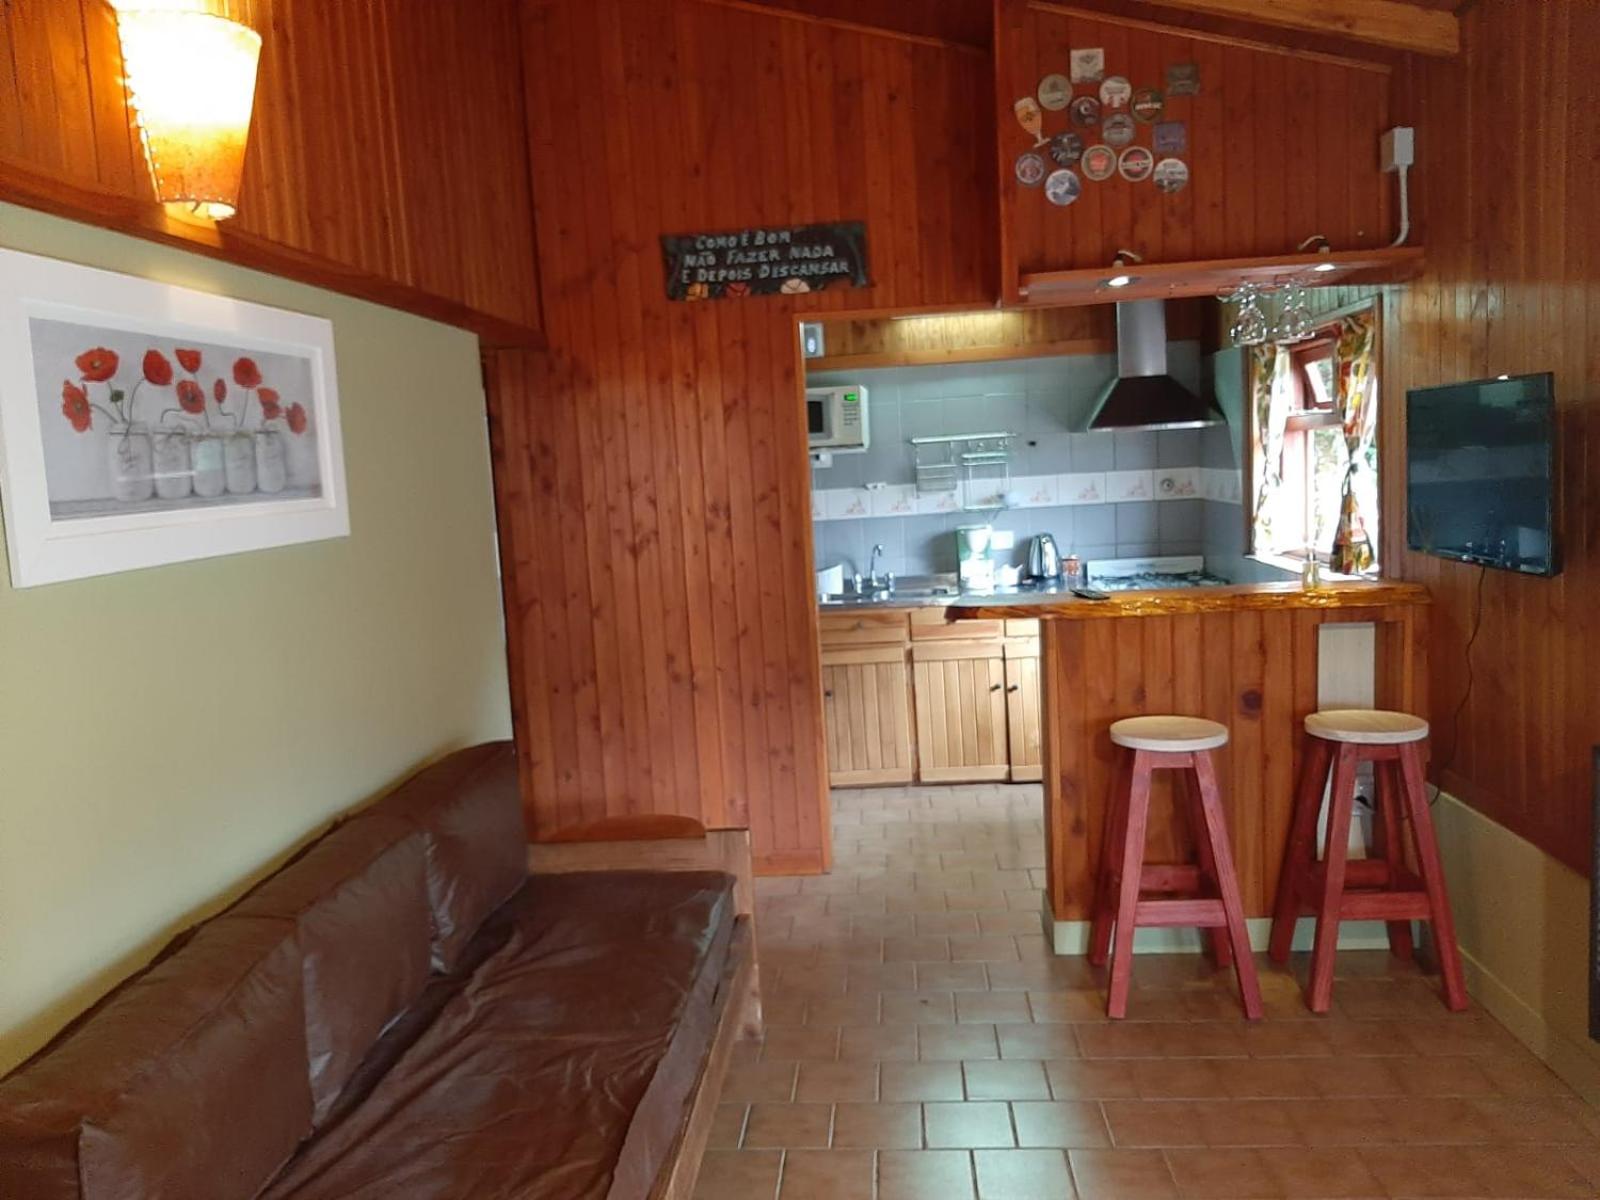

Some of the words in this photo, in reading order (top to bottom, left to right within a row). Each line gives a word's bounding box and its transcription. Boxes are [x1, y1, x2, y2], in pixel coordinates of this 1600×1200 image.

[696, 236, 737, 249] COMO
[754, 231, 790, 245] BOM
[684, 251, 715, 268] NÃO
[727, 249, 780, 264] FAZER
[790, 245, 834, 259] NADA
[681, 270, 690, 283] E
[697, 268, 752, 282] DEPOIS
[759, 262, 849, 278] DESCANSAR
